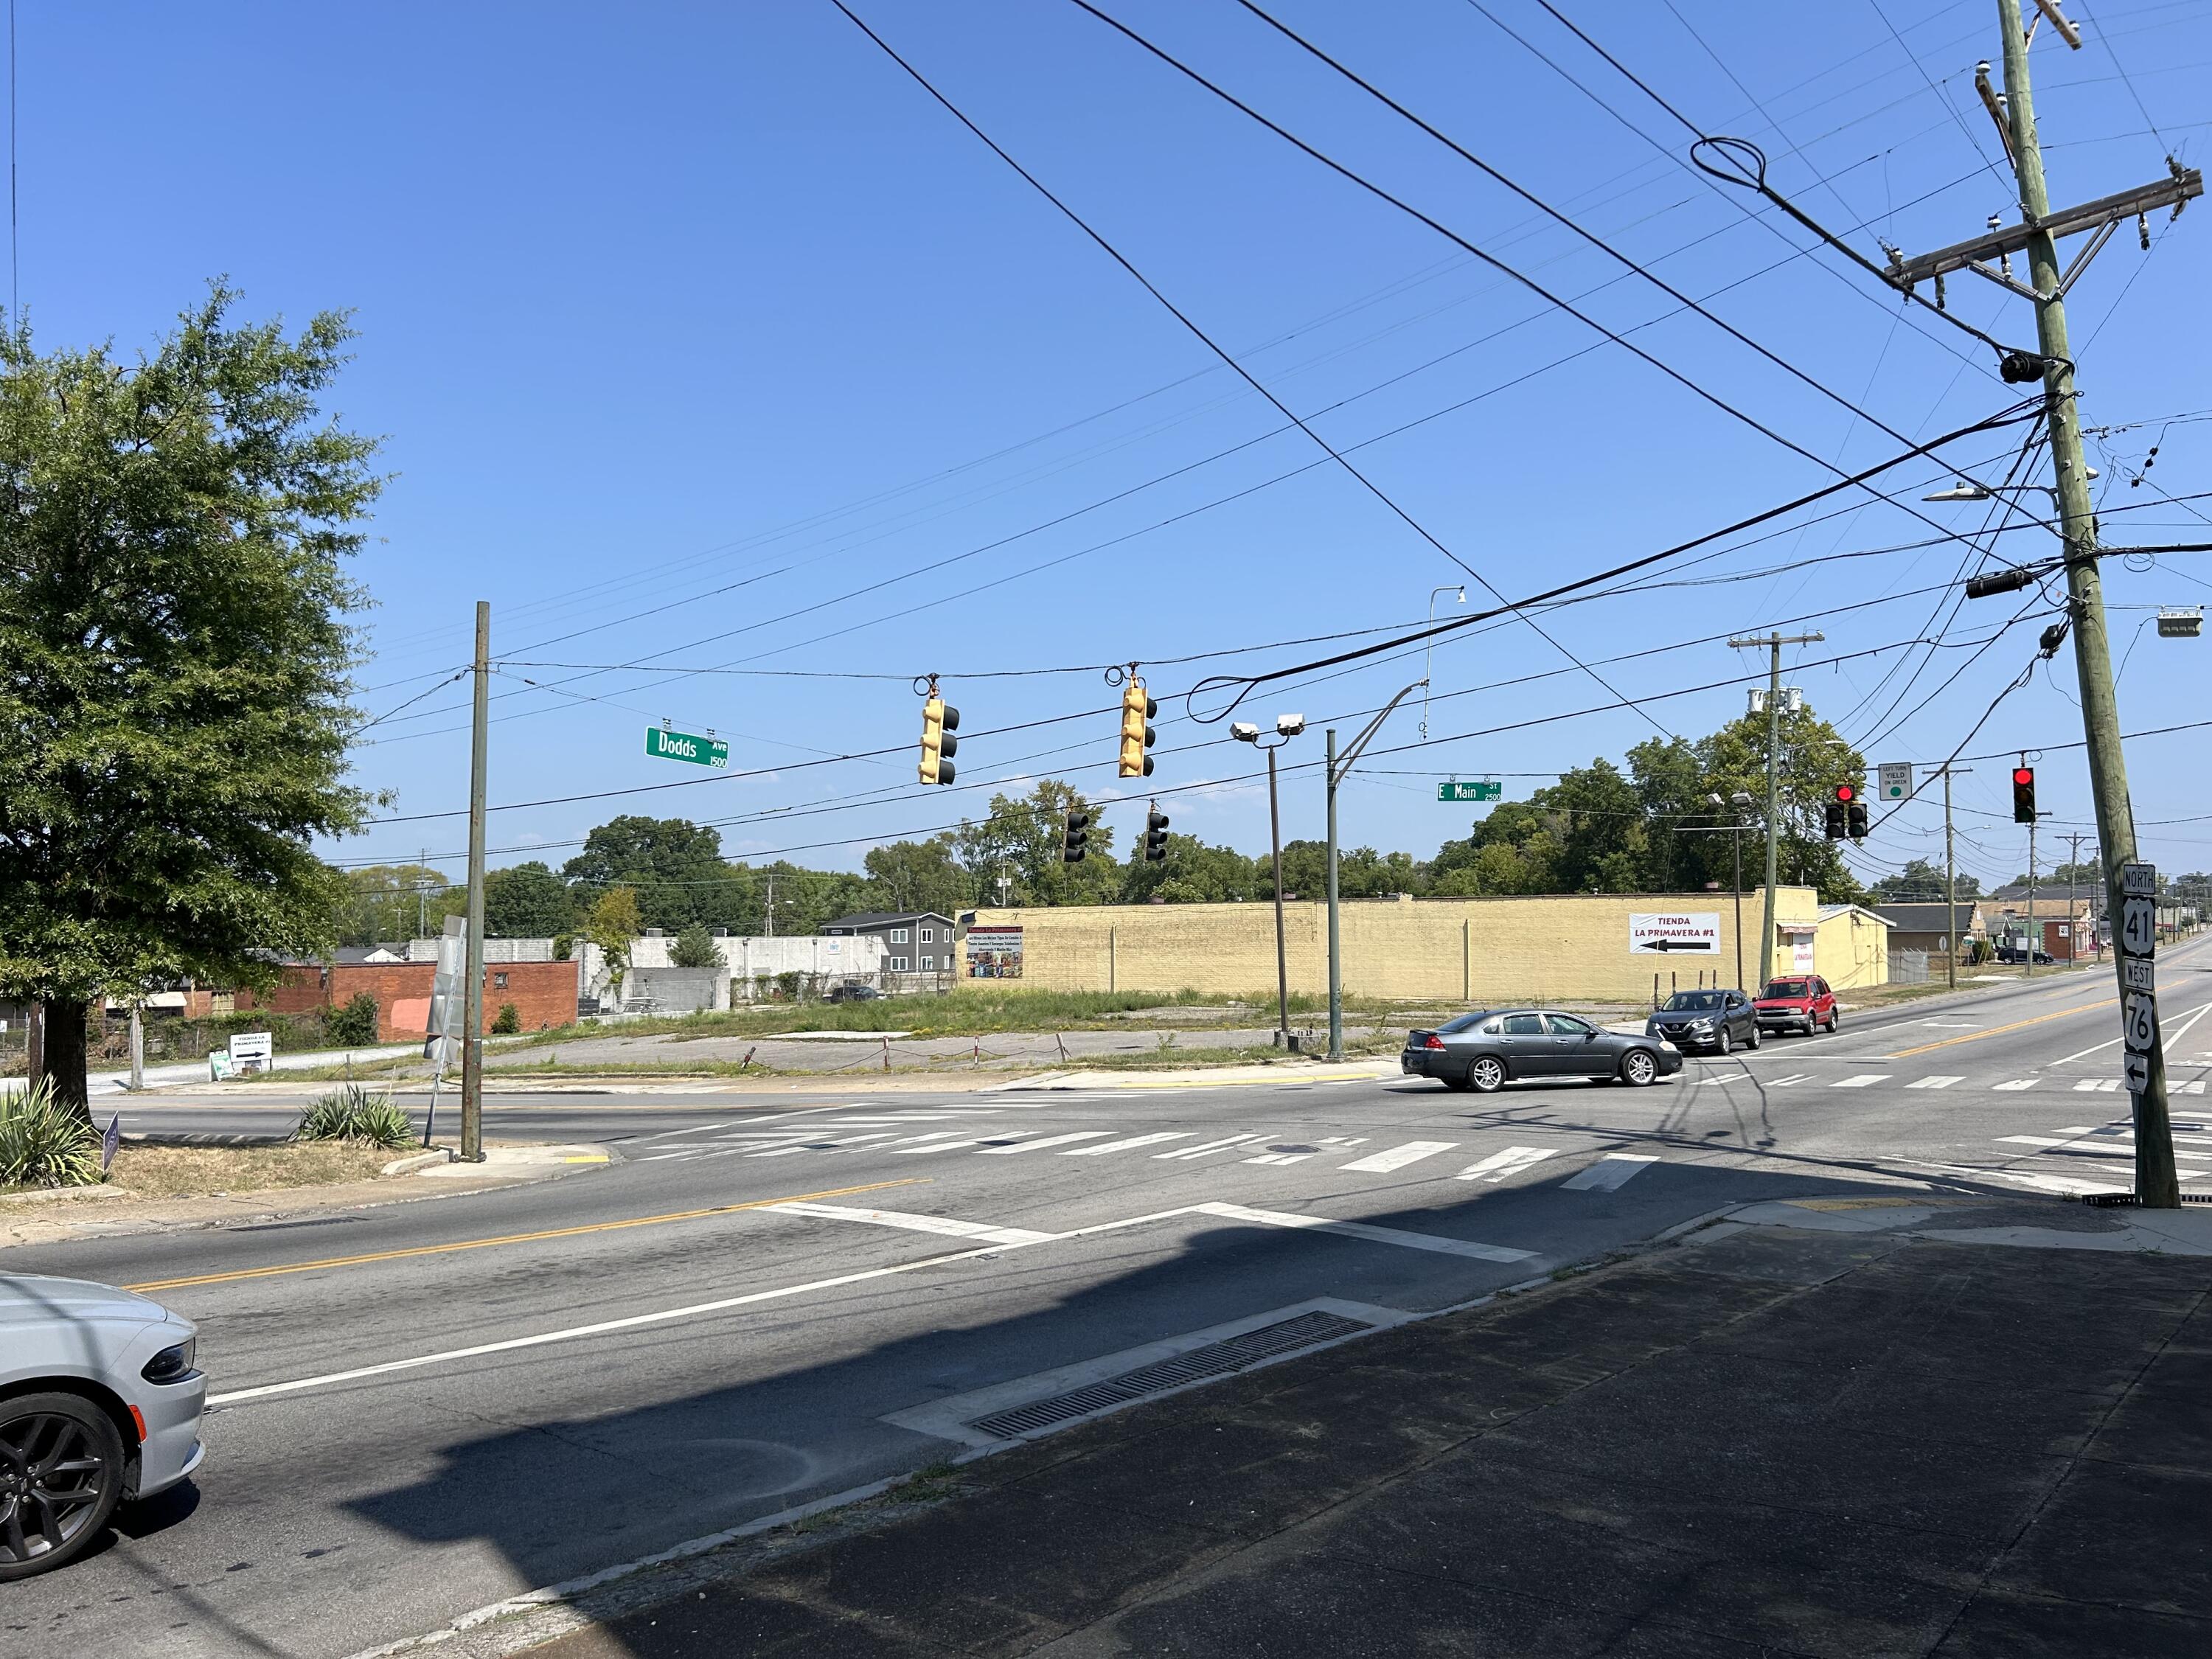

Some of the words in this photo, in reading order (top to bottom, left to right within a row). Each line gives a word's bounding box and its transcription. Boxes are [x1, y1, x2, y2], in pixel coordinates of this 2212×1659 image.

[658, 731, 696, 757] Dodds
[712, 742, 727, 751] Ave
[710, 757, 727, 768] 1500
[1439, 784, 1444, 799] E
[1455, 784, 1476, 799] Main
[2125, 871, 2153, 888] NORTH
[2126, 910, 2147, 942] 41
[2128, 964, 2149, 984] WEST
[2128, 1005, 2149, 1039] 76
